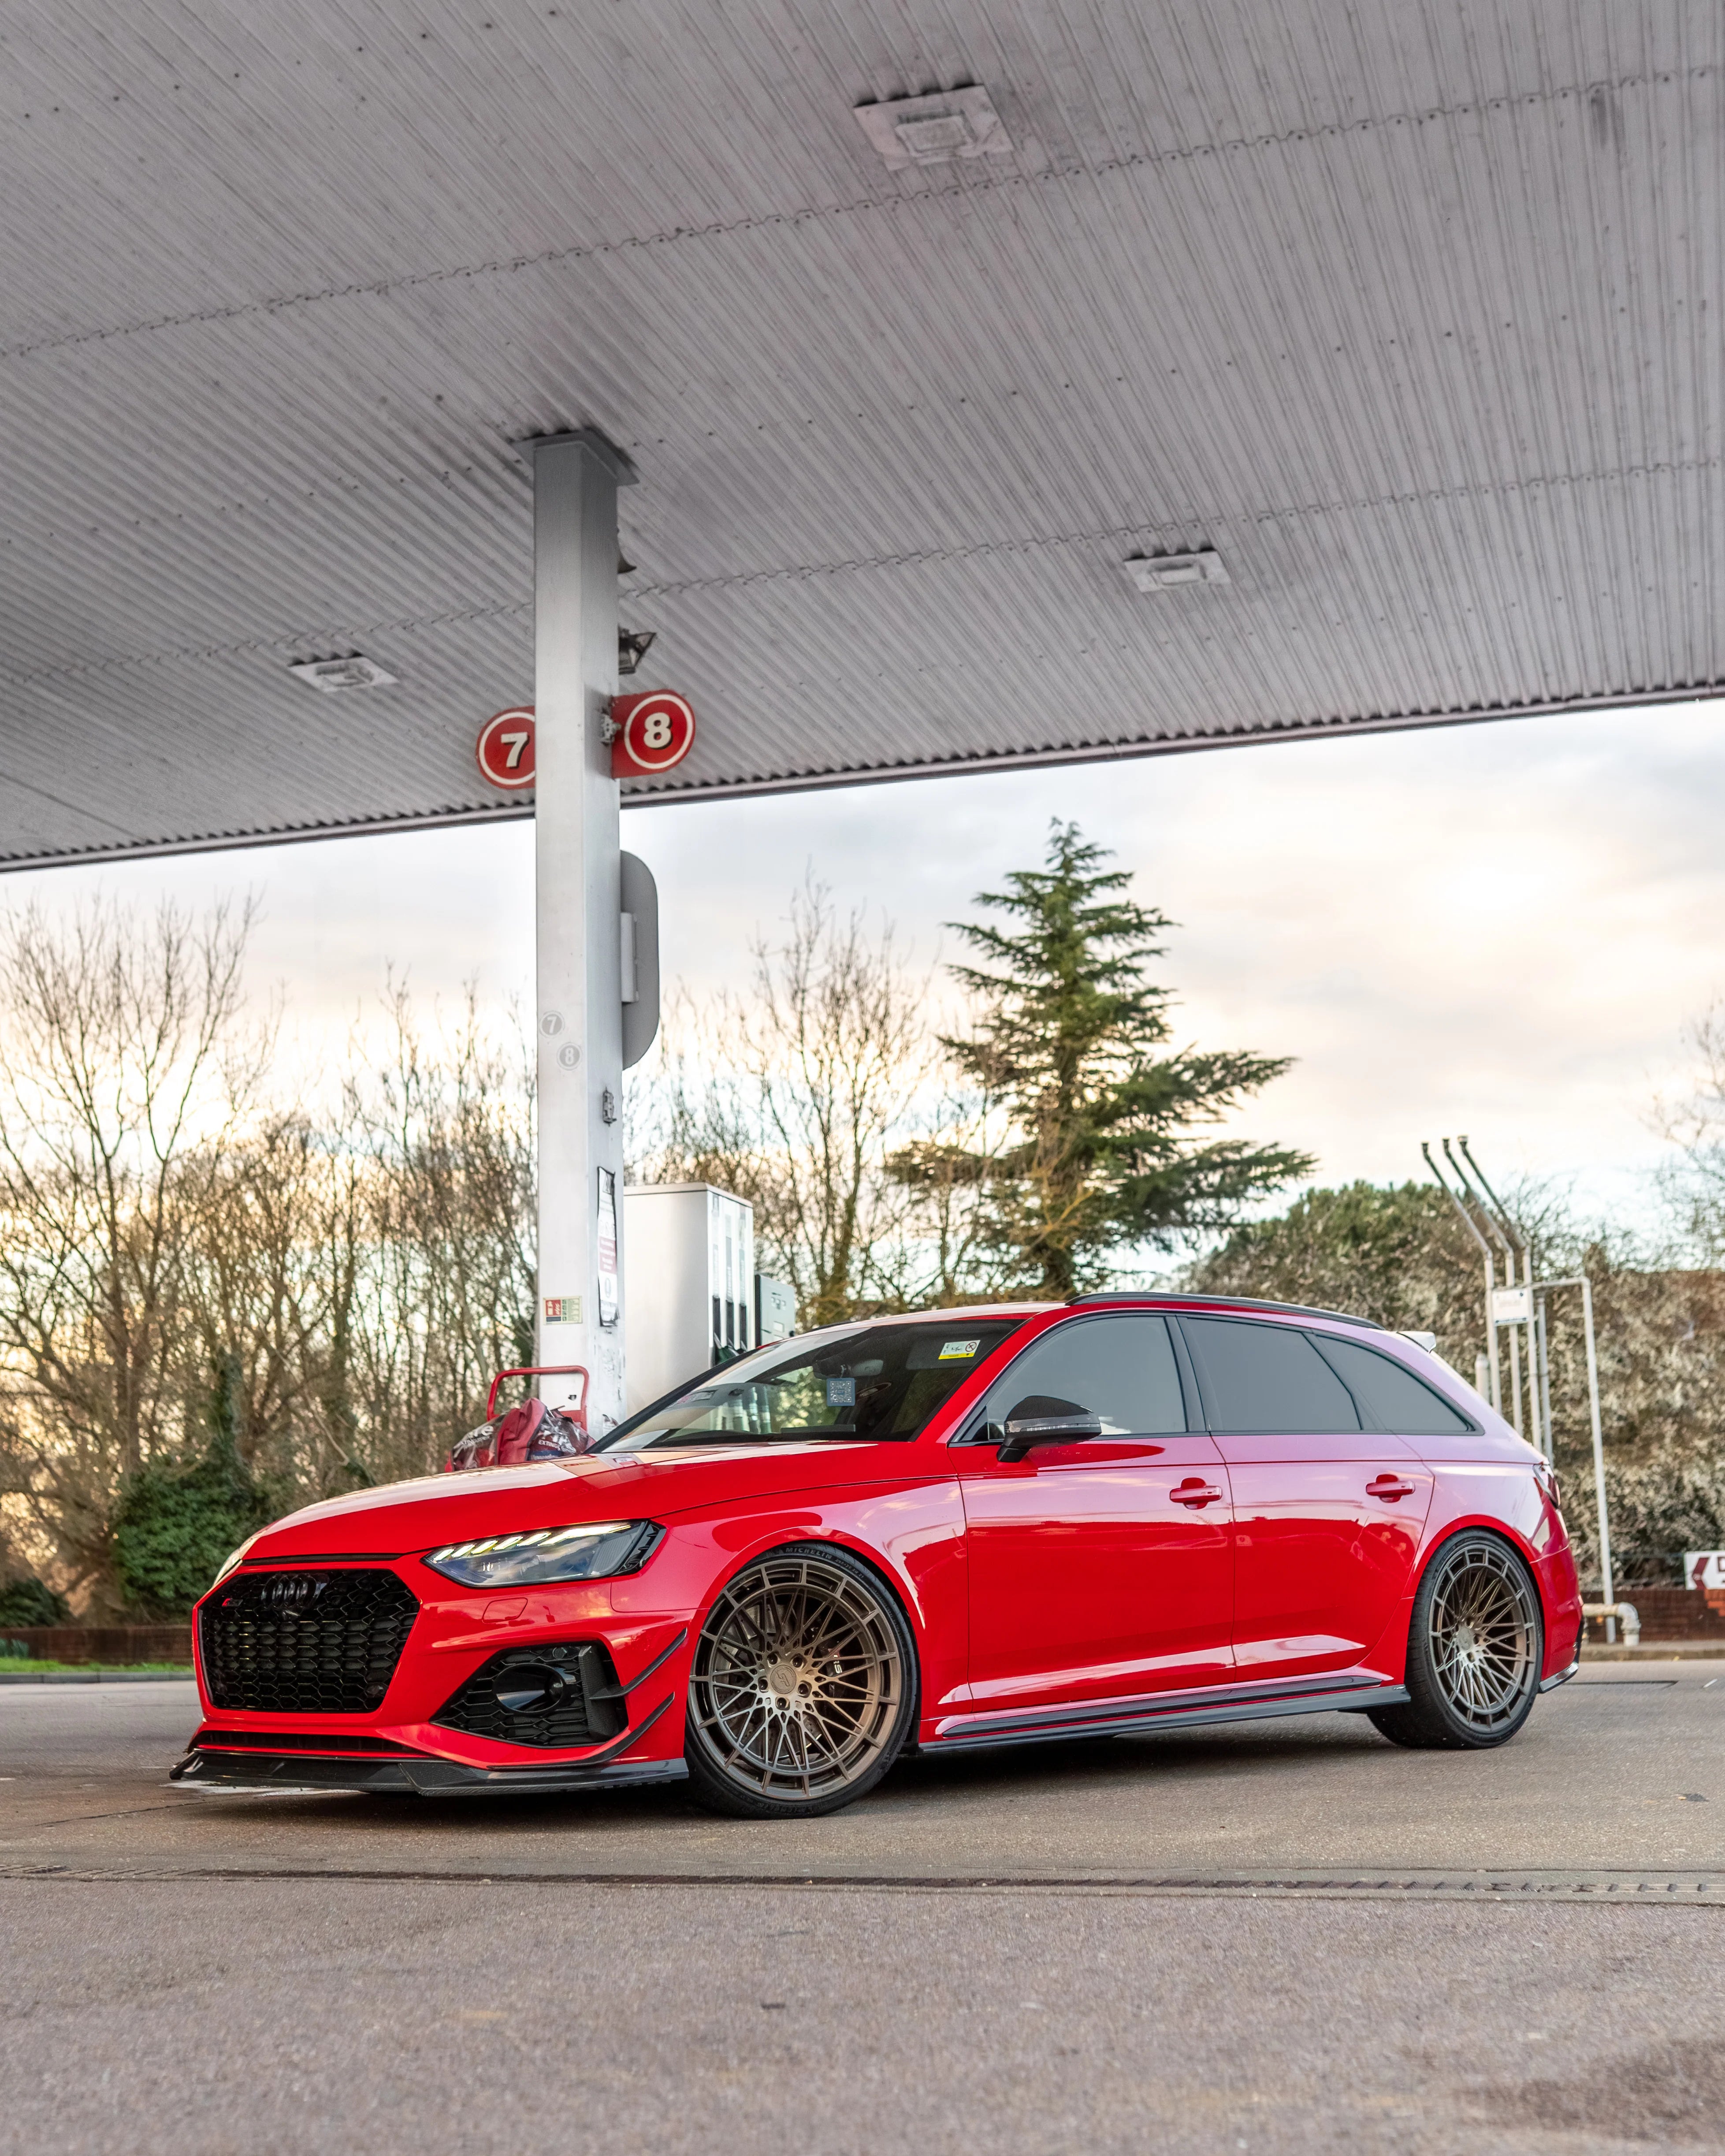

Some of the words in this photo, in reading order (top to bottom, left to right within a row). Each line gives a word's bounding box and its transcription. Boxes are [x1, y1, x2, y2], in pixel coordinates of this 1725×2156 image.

[643, 712, 673, 750] 8
[501, 732, 530, 769] 7
[546, 1017, 558, 1033] 7
[565, 1048, 575, 1066] 8
[786, 1548, 832, 1559] MICHELIN
